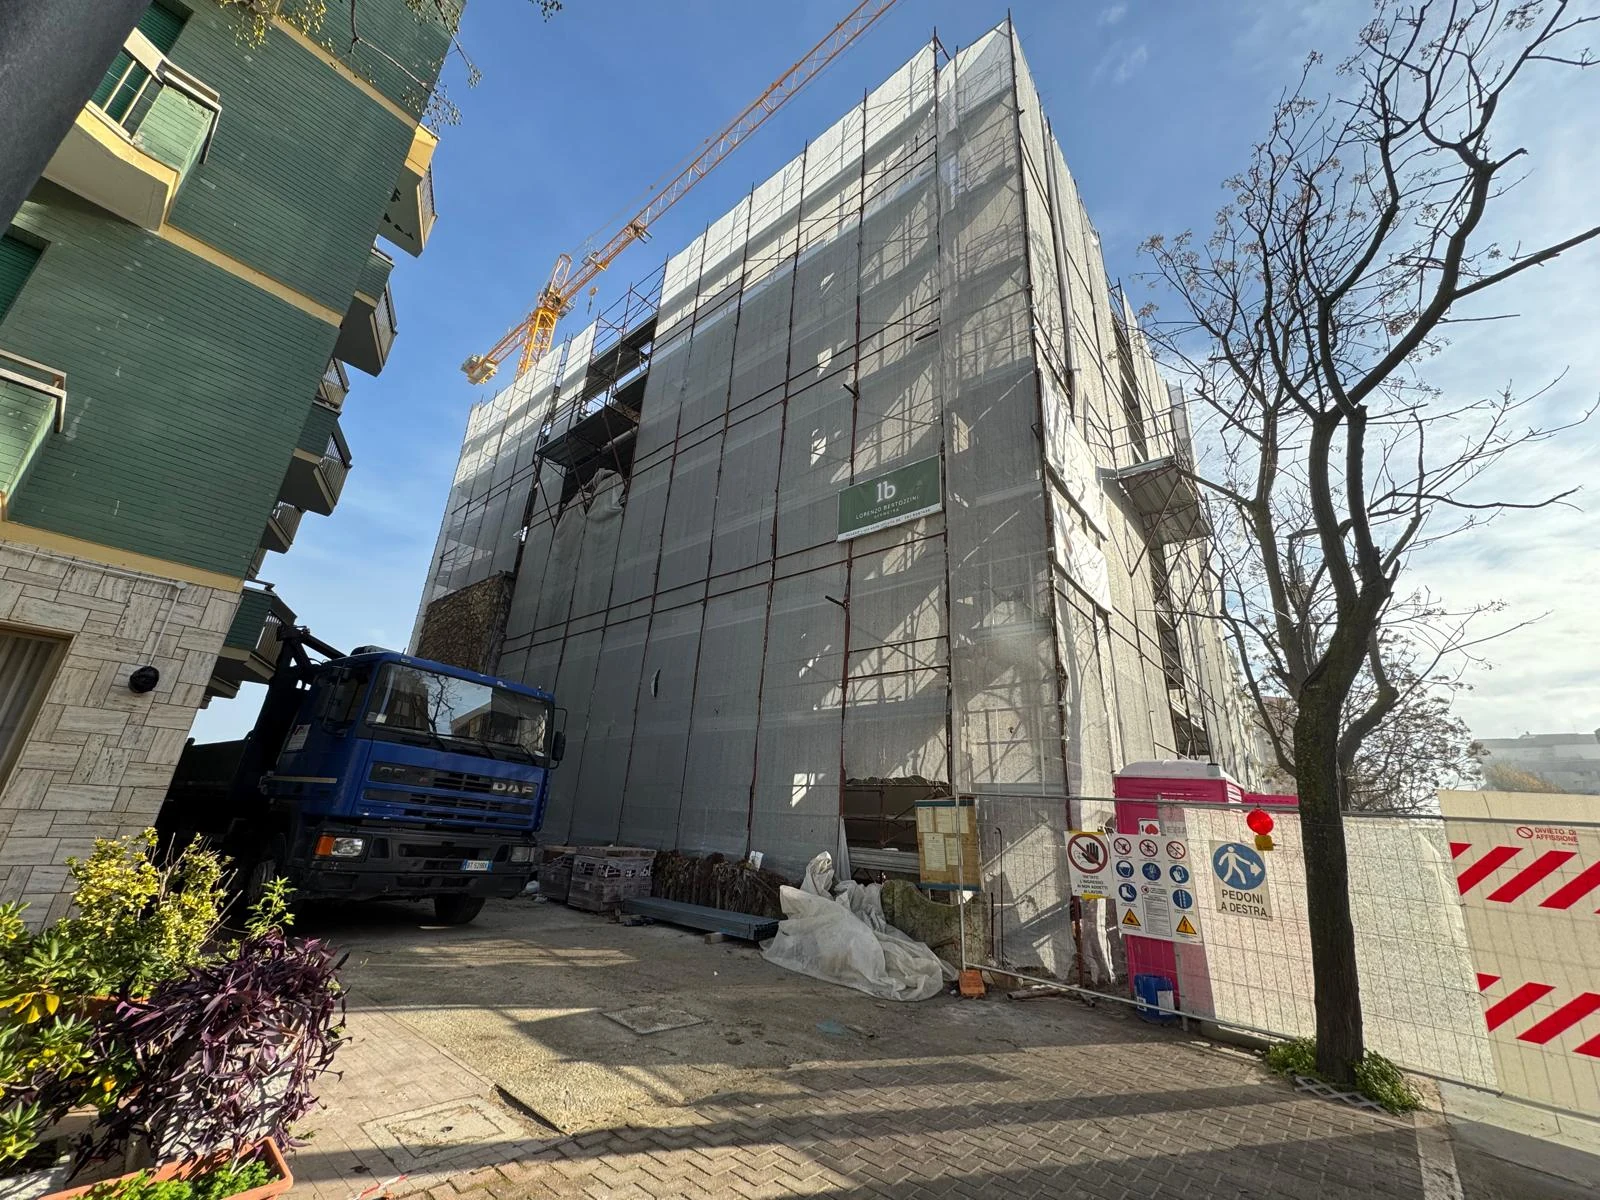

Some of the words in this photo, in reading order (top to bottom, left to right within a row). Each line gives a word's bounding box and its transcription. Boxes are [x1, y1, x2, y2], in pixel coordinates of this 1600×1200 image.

[492, 782, 534, 794] DAF
[1534, 827, 1565, 835] DIVIETO
[1536, 833, 1578, 842] AFFISSIONE
[1221, 889, 1264, 904] PEDONI
[1221, 901, 1228, 911] A
[1229, 902, 1268, 917] DESTRA
